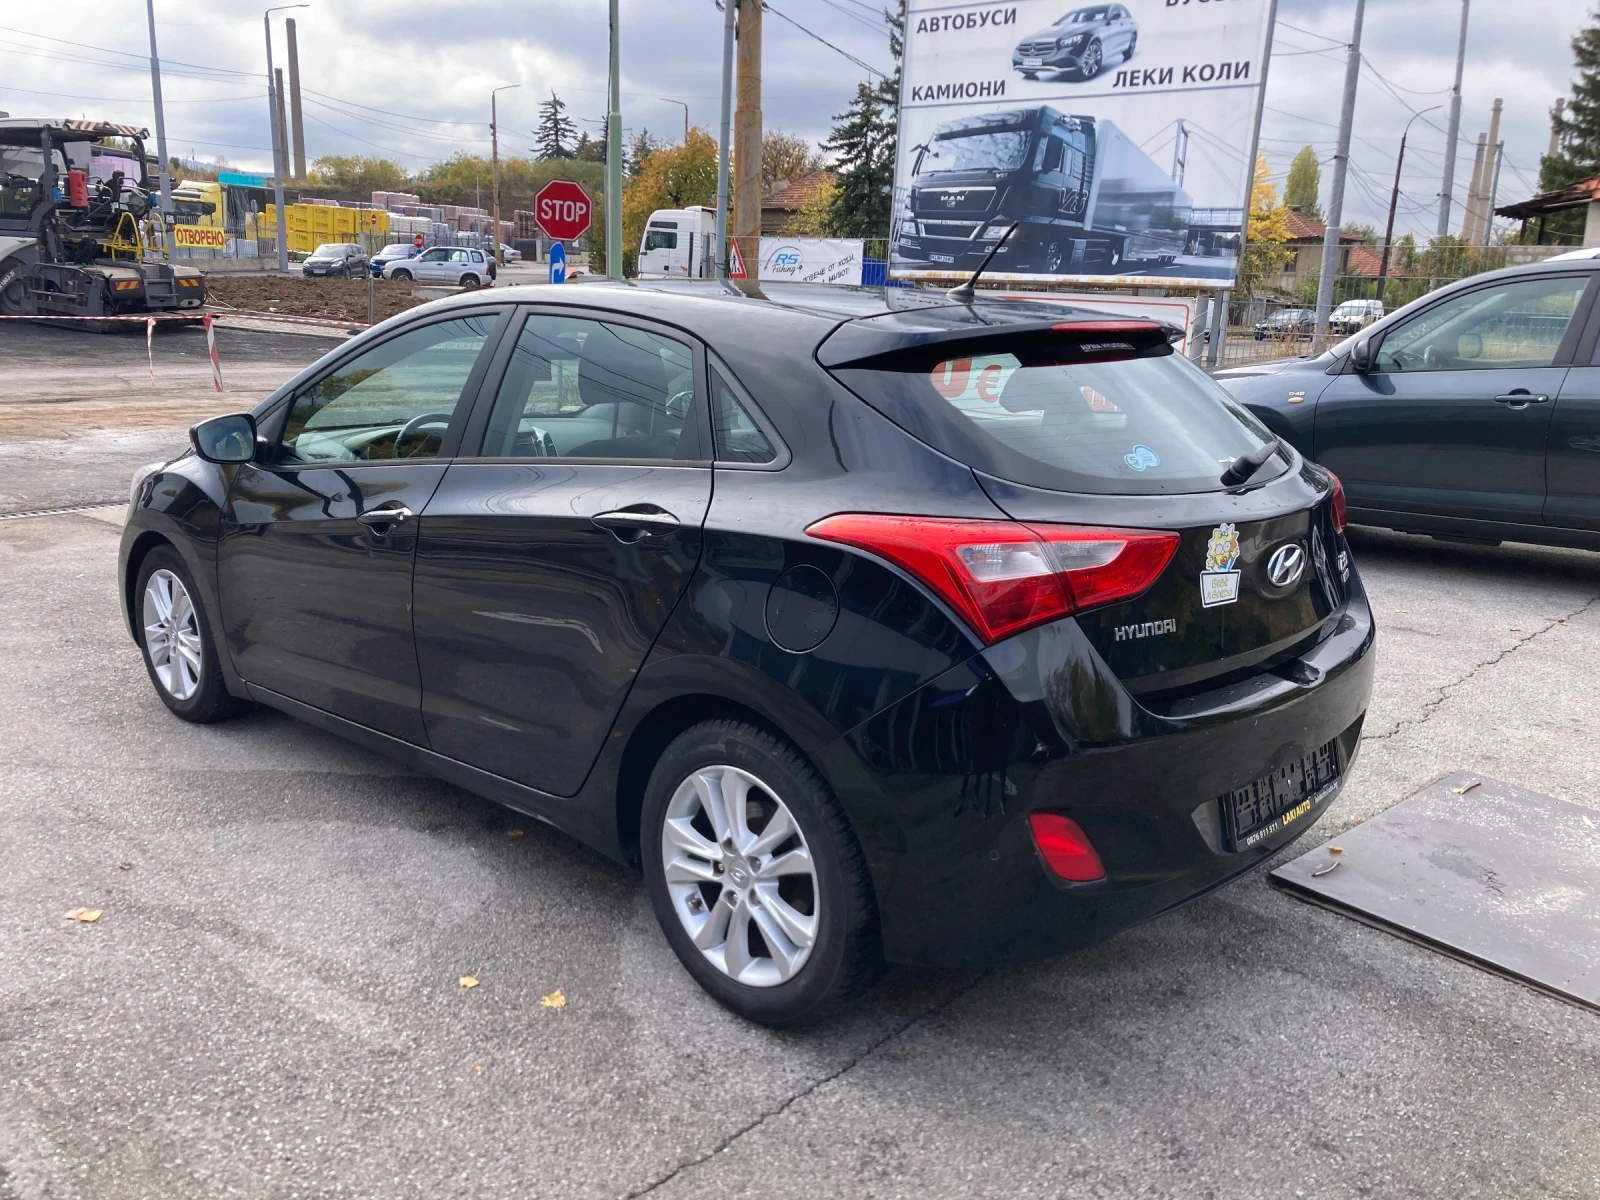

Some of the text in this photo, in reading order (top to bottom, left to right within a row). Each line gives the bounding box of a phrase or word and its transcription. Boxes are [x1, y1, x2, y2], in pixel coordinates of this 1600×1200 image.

[916, 7, 1018, 34] АВТОБУСИ
[1112, 61, 1251, 88] ЛЕКИ КОЛИ
[911, 79, 1006, 101] КАМИОНИ
[540, 198, 587, 223] STOP
[176, 227, 225, 246] ОТВОРЕНО
[772, 263, 796, 276] Fishing
[775, 253, 800, 264] RS
[1114, 618, 1177, 642] HYUNDAI
[1246, 832, 1260, 846] 0876
[1259, 827, 1269, 839] 911
